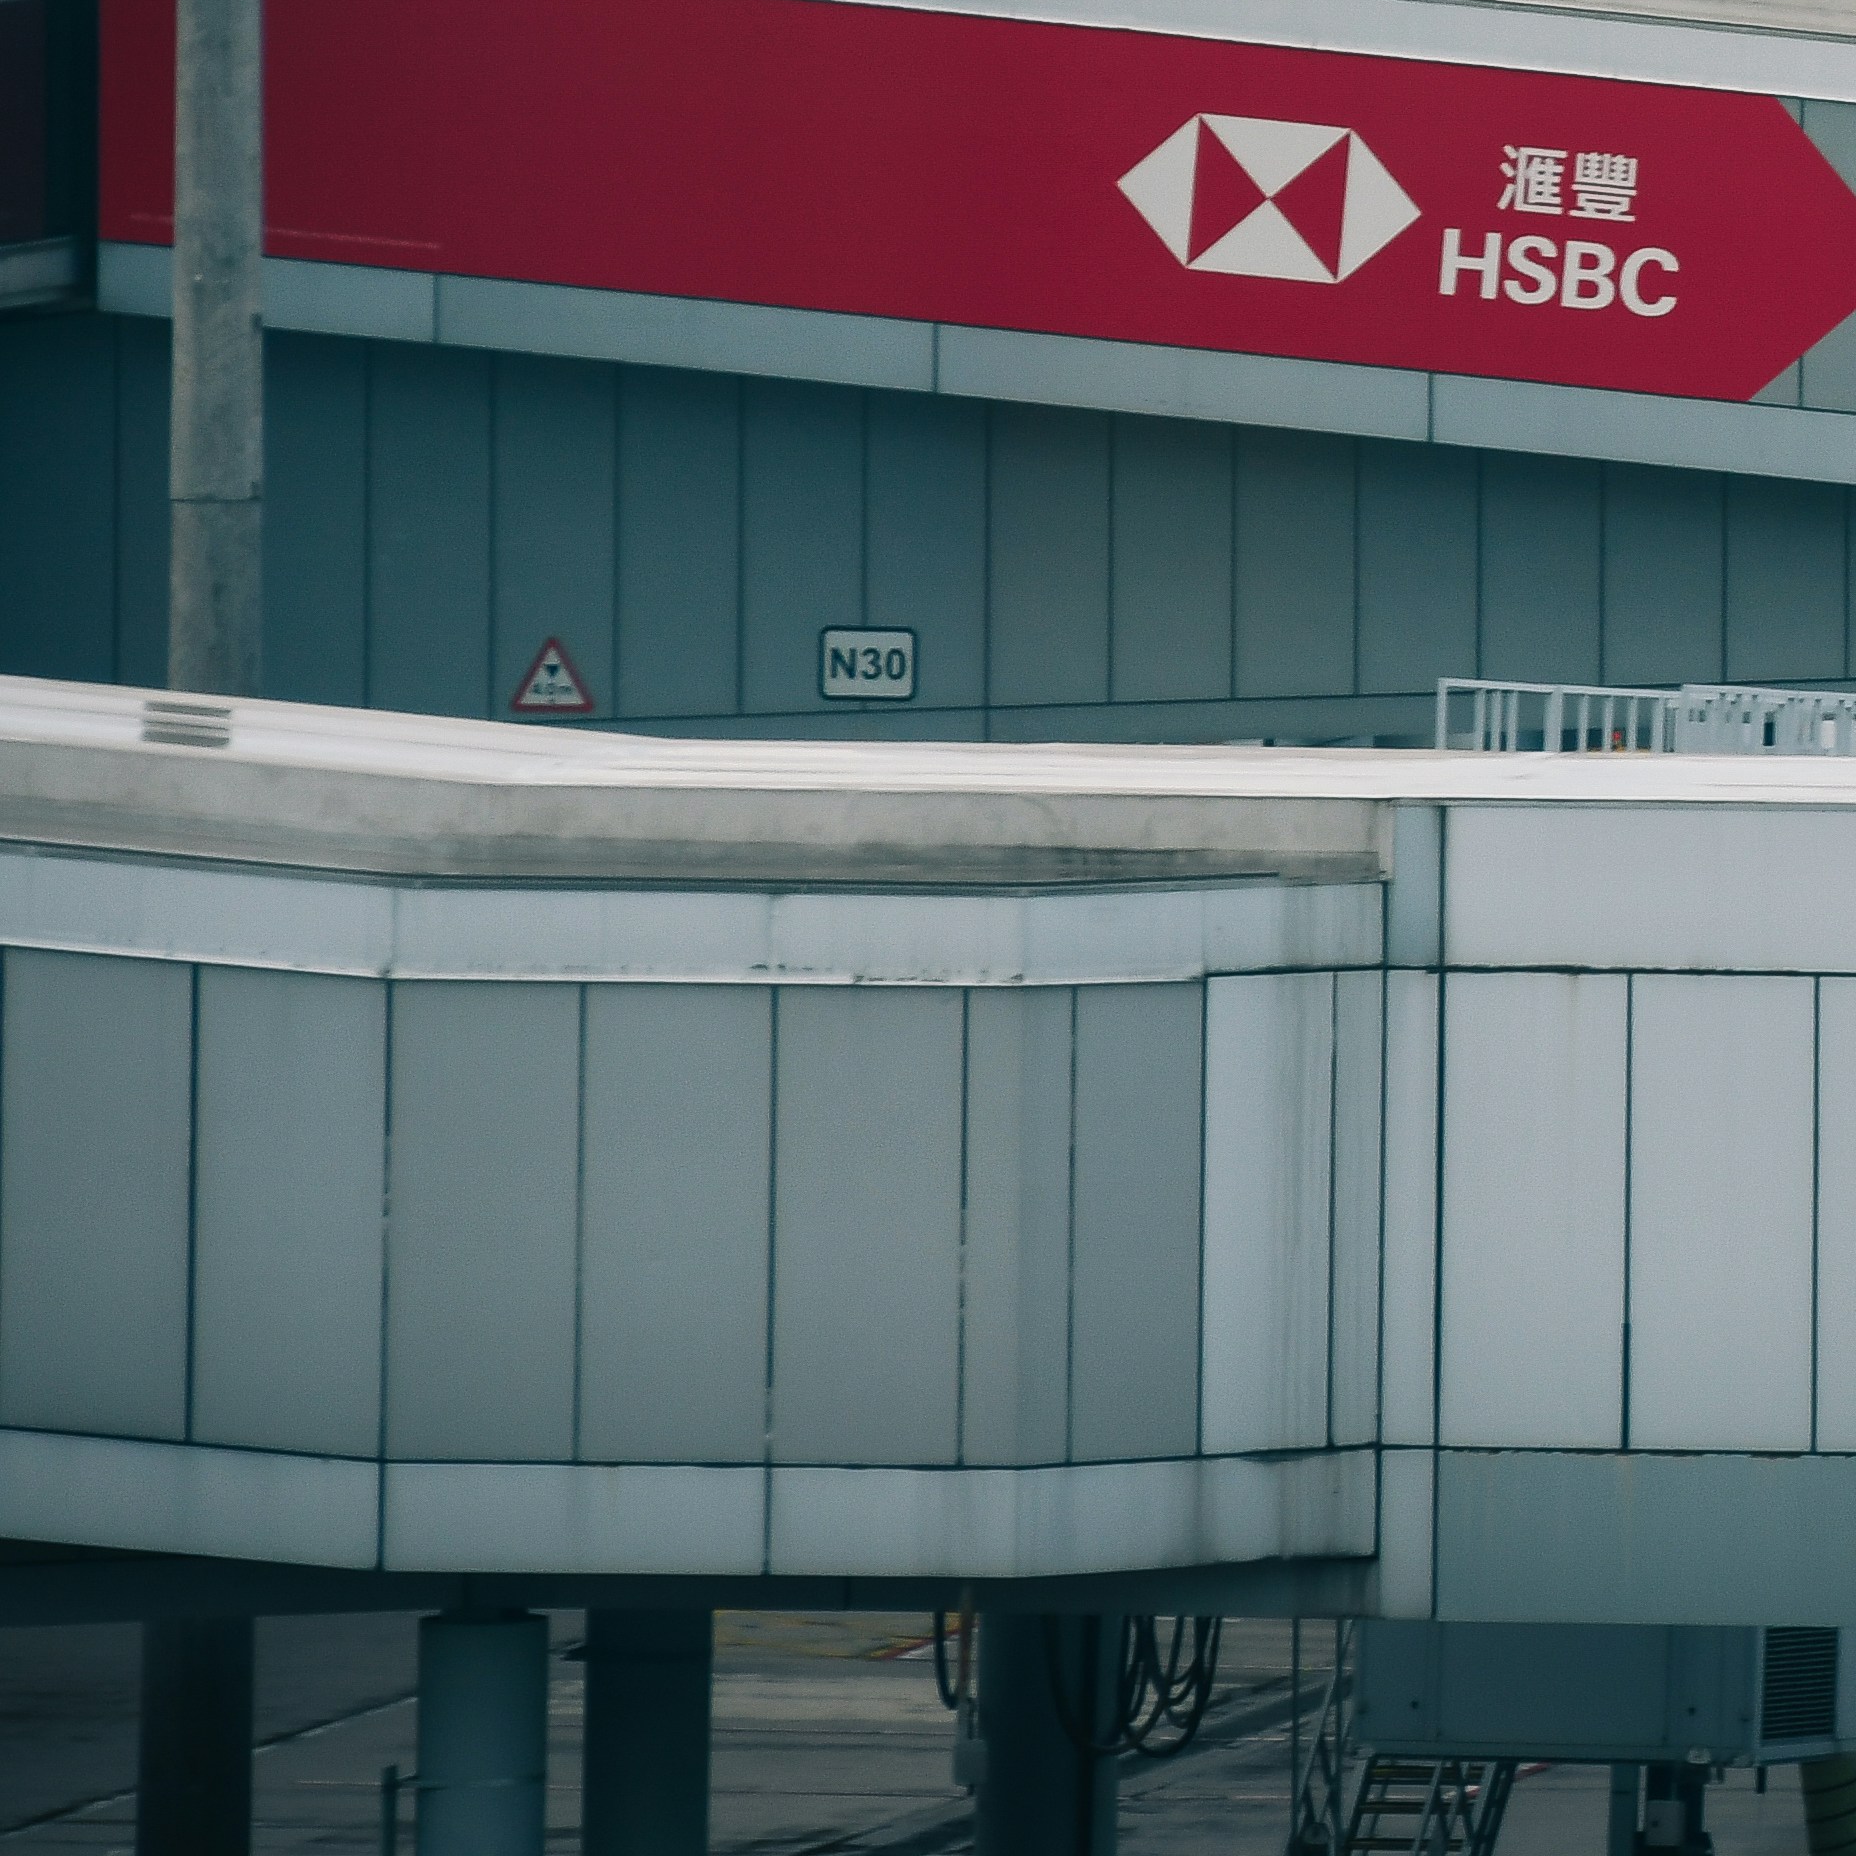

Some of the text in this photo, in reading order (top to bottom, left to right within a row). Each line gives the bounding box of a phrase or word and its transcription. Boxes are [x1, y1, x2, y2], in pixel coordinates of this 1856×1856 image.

[1497, 145, 1638, 222] 滙豐
[1439, 228, 1680, 316] HSBC
[831, 647, 906, 679] N30
